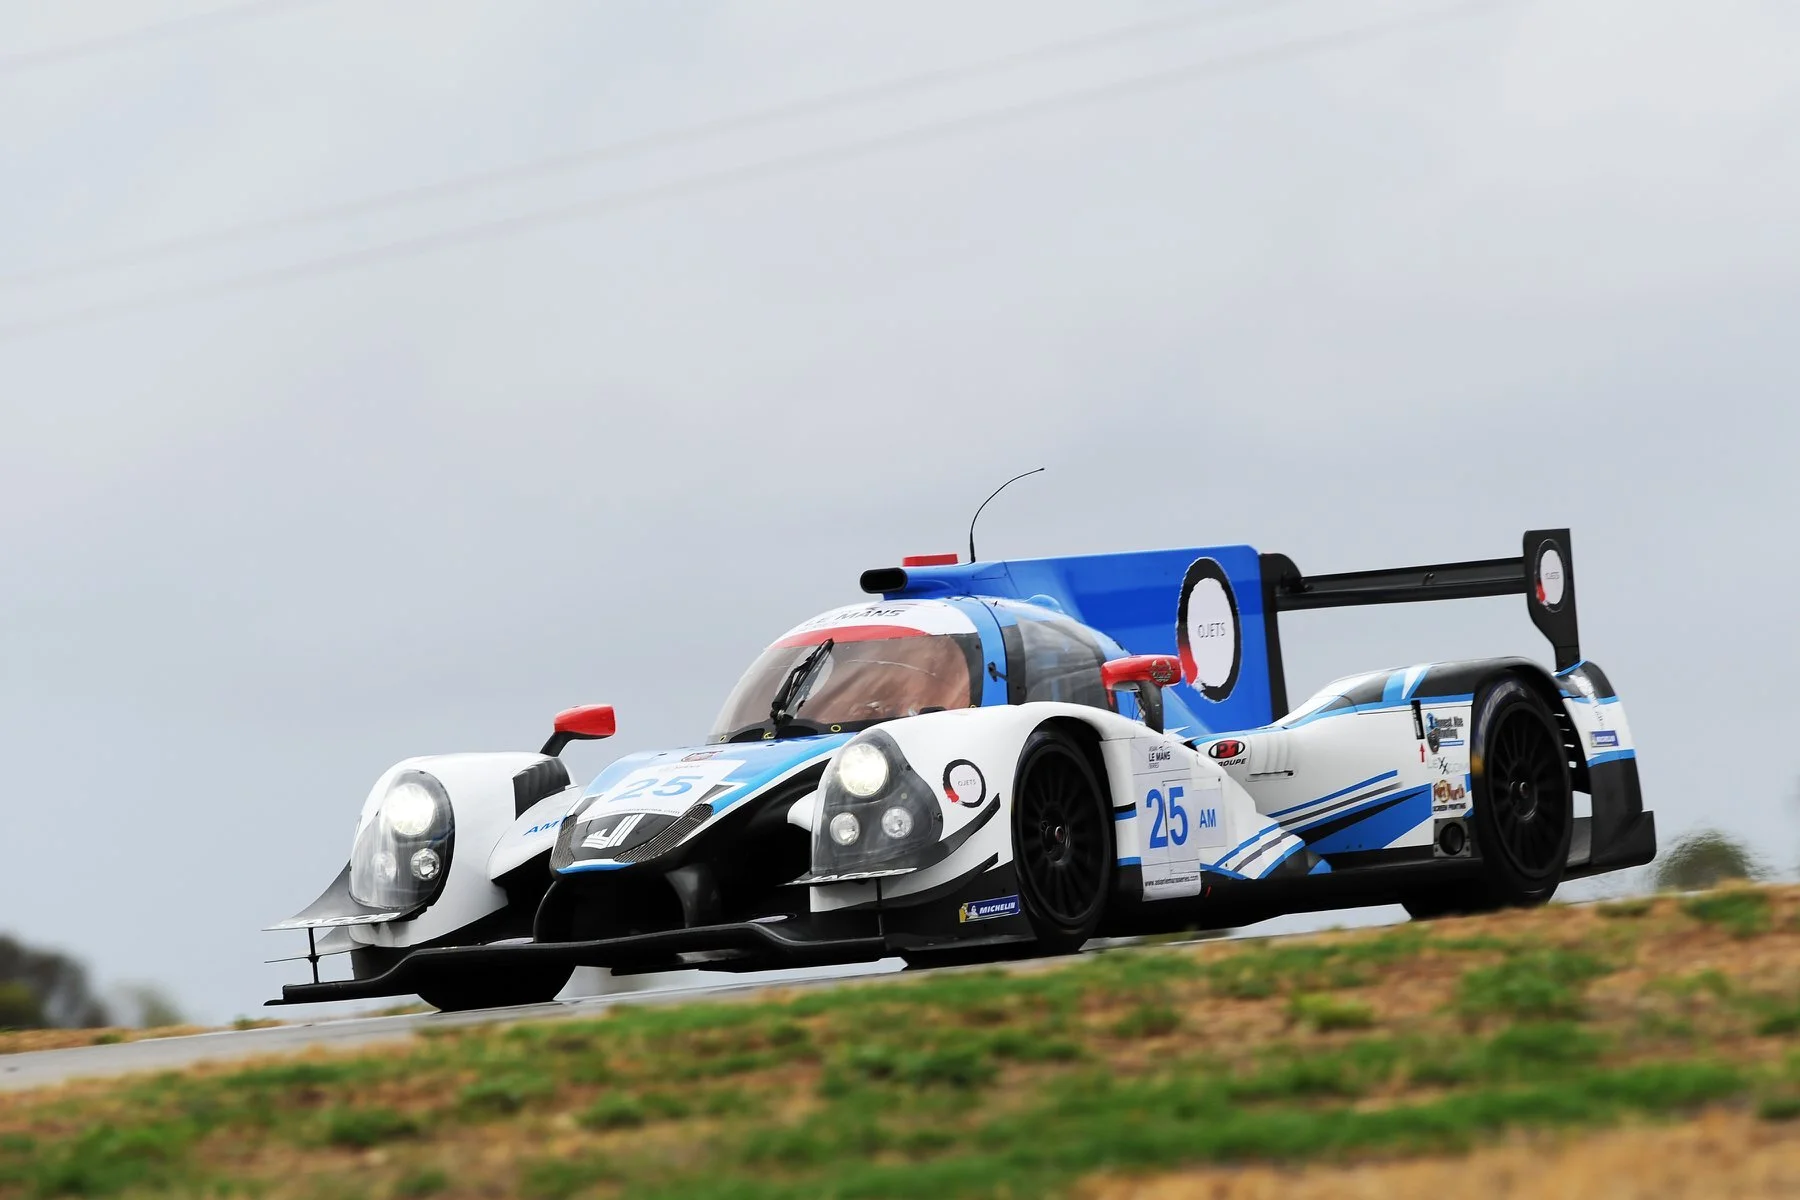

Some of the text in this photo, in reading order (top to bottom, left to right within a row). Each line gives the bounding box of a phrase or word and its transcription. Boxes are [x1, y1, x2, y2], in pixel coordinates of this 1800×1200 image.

[834, 609, 905, 621] MANS
[1148, 750, 1171, 762] LE MANS
[607, 775, 704, 803] 25
[1146, 786, 1217, 849] 25 AM
[979, 901, 1016, 915] MICHELIN
